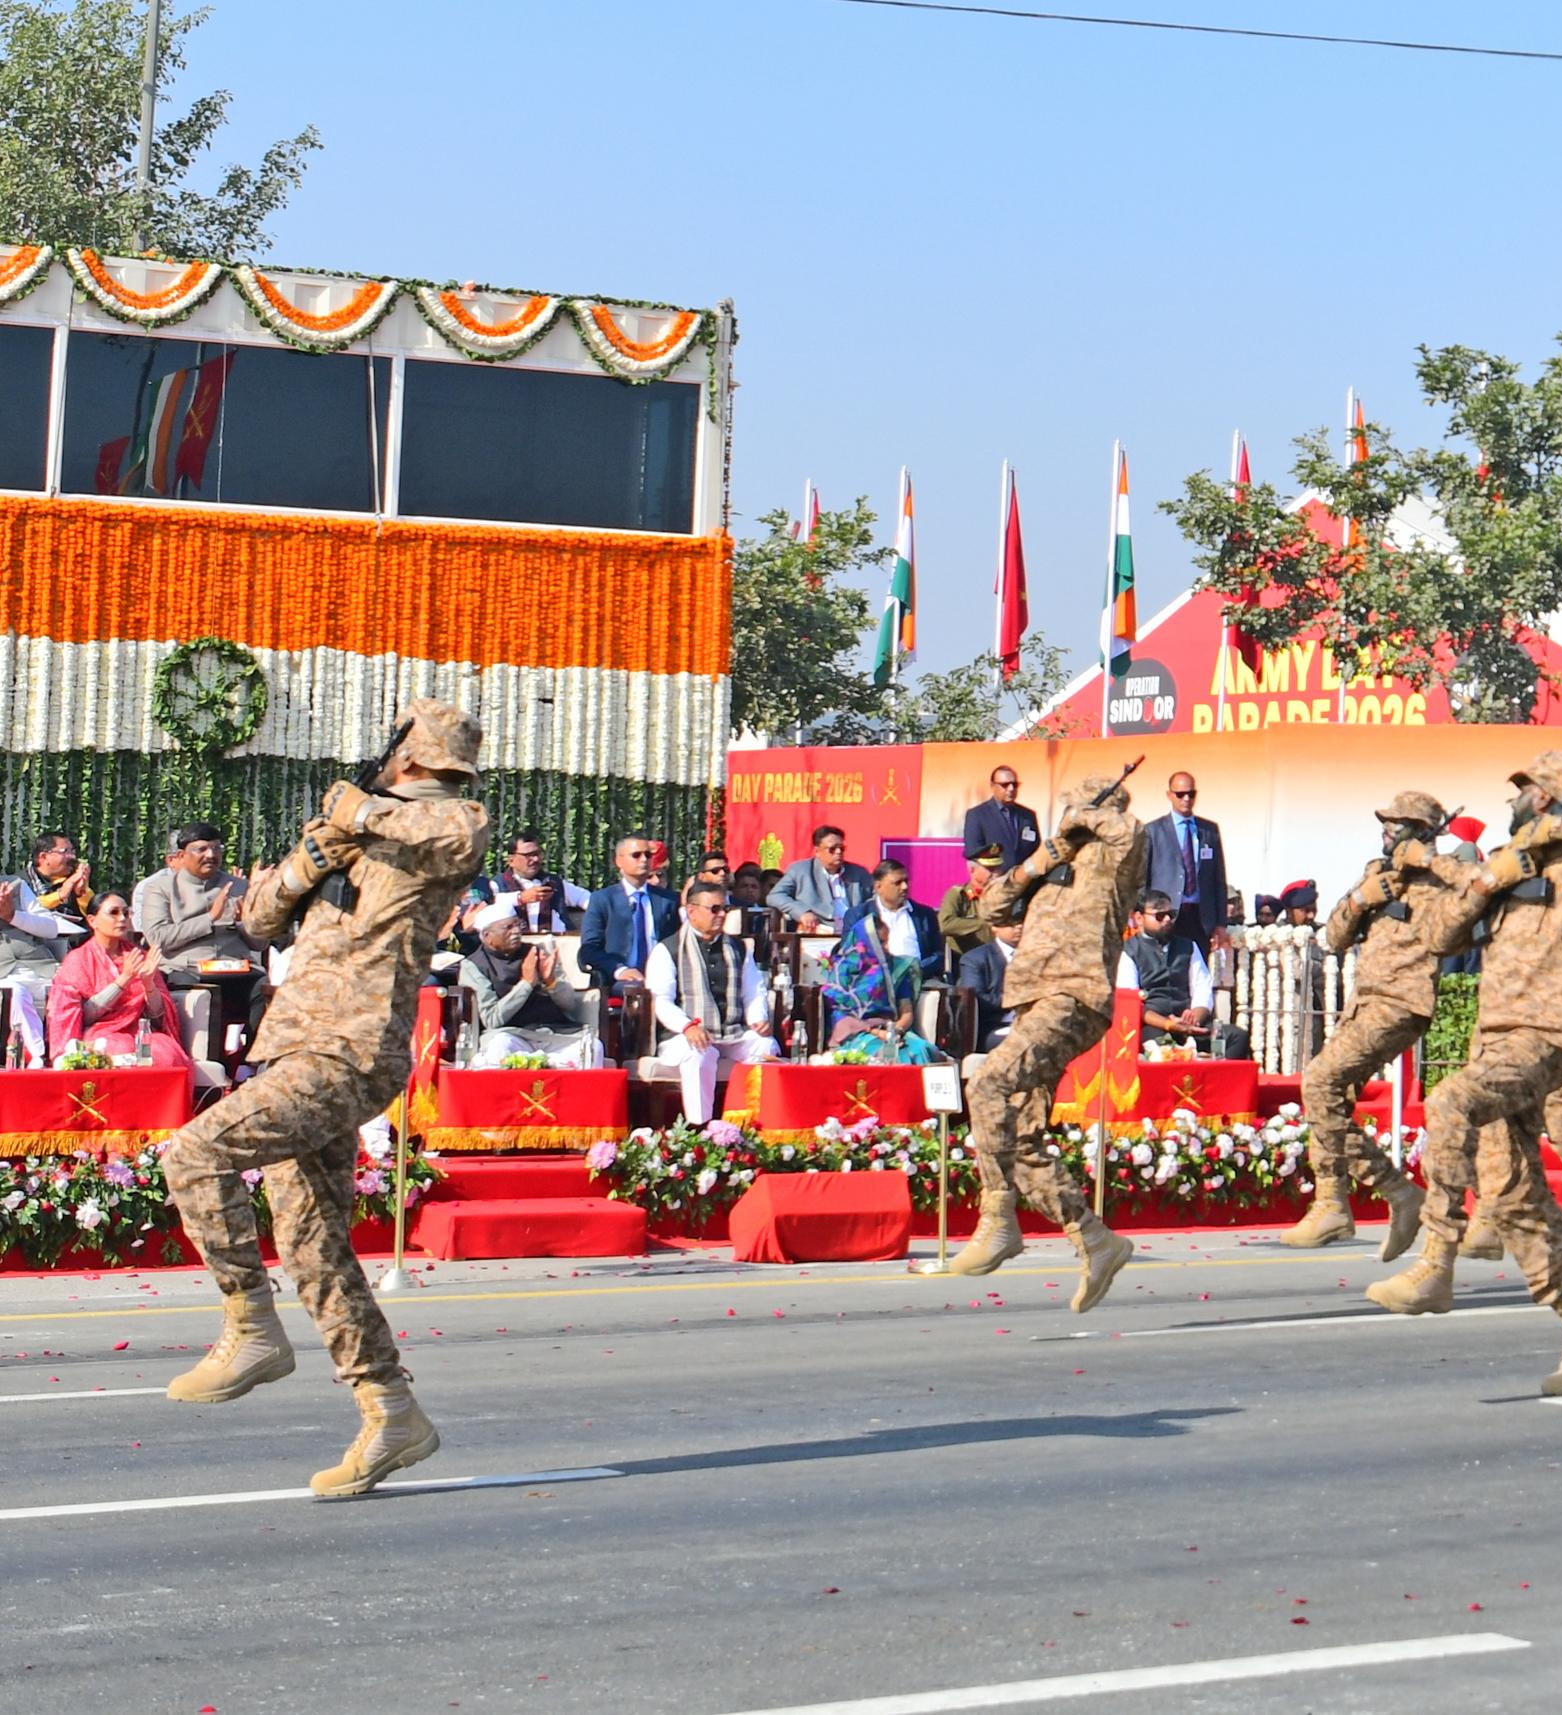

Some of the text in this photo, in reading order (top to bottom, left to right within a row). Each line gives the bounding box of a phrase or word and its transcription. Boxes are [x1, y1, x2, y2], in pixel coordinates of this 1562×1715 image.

[1109, 695, 1175, 724] SINDOOR
[732, 771, 864, 803] DAY PARADE 2026
